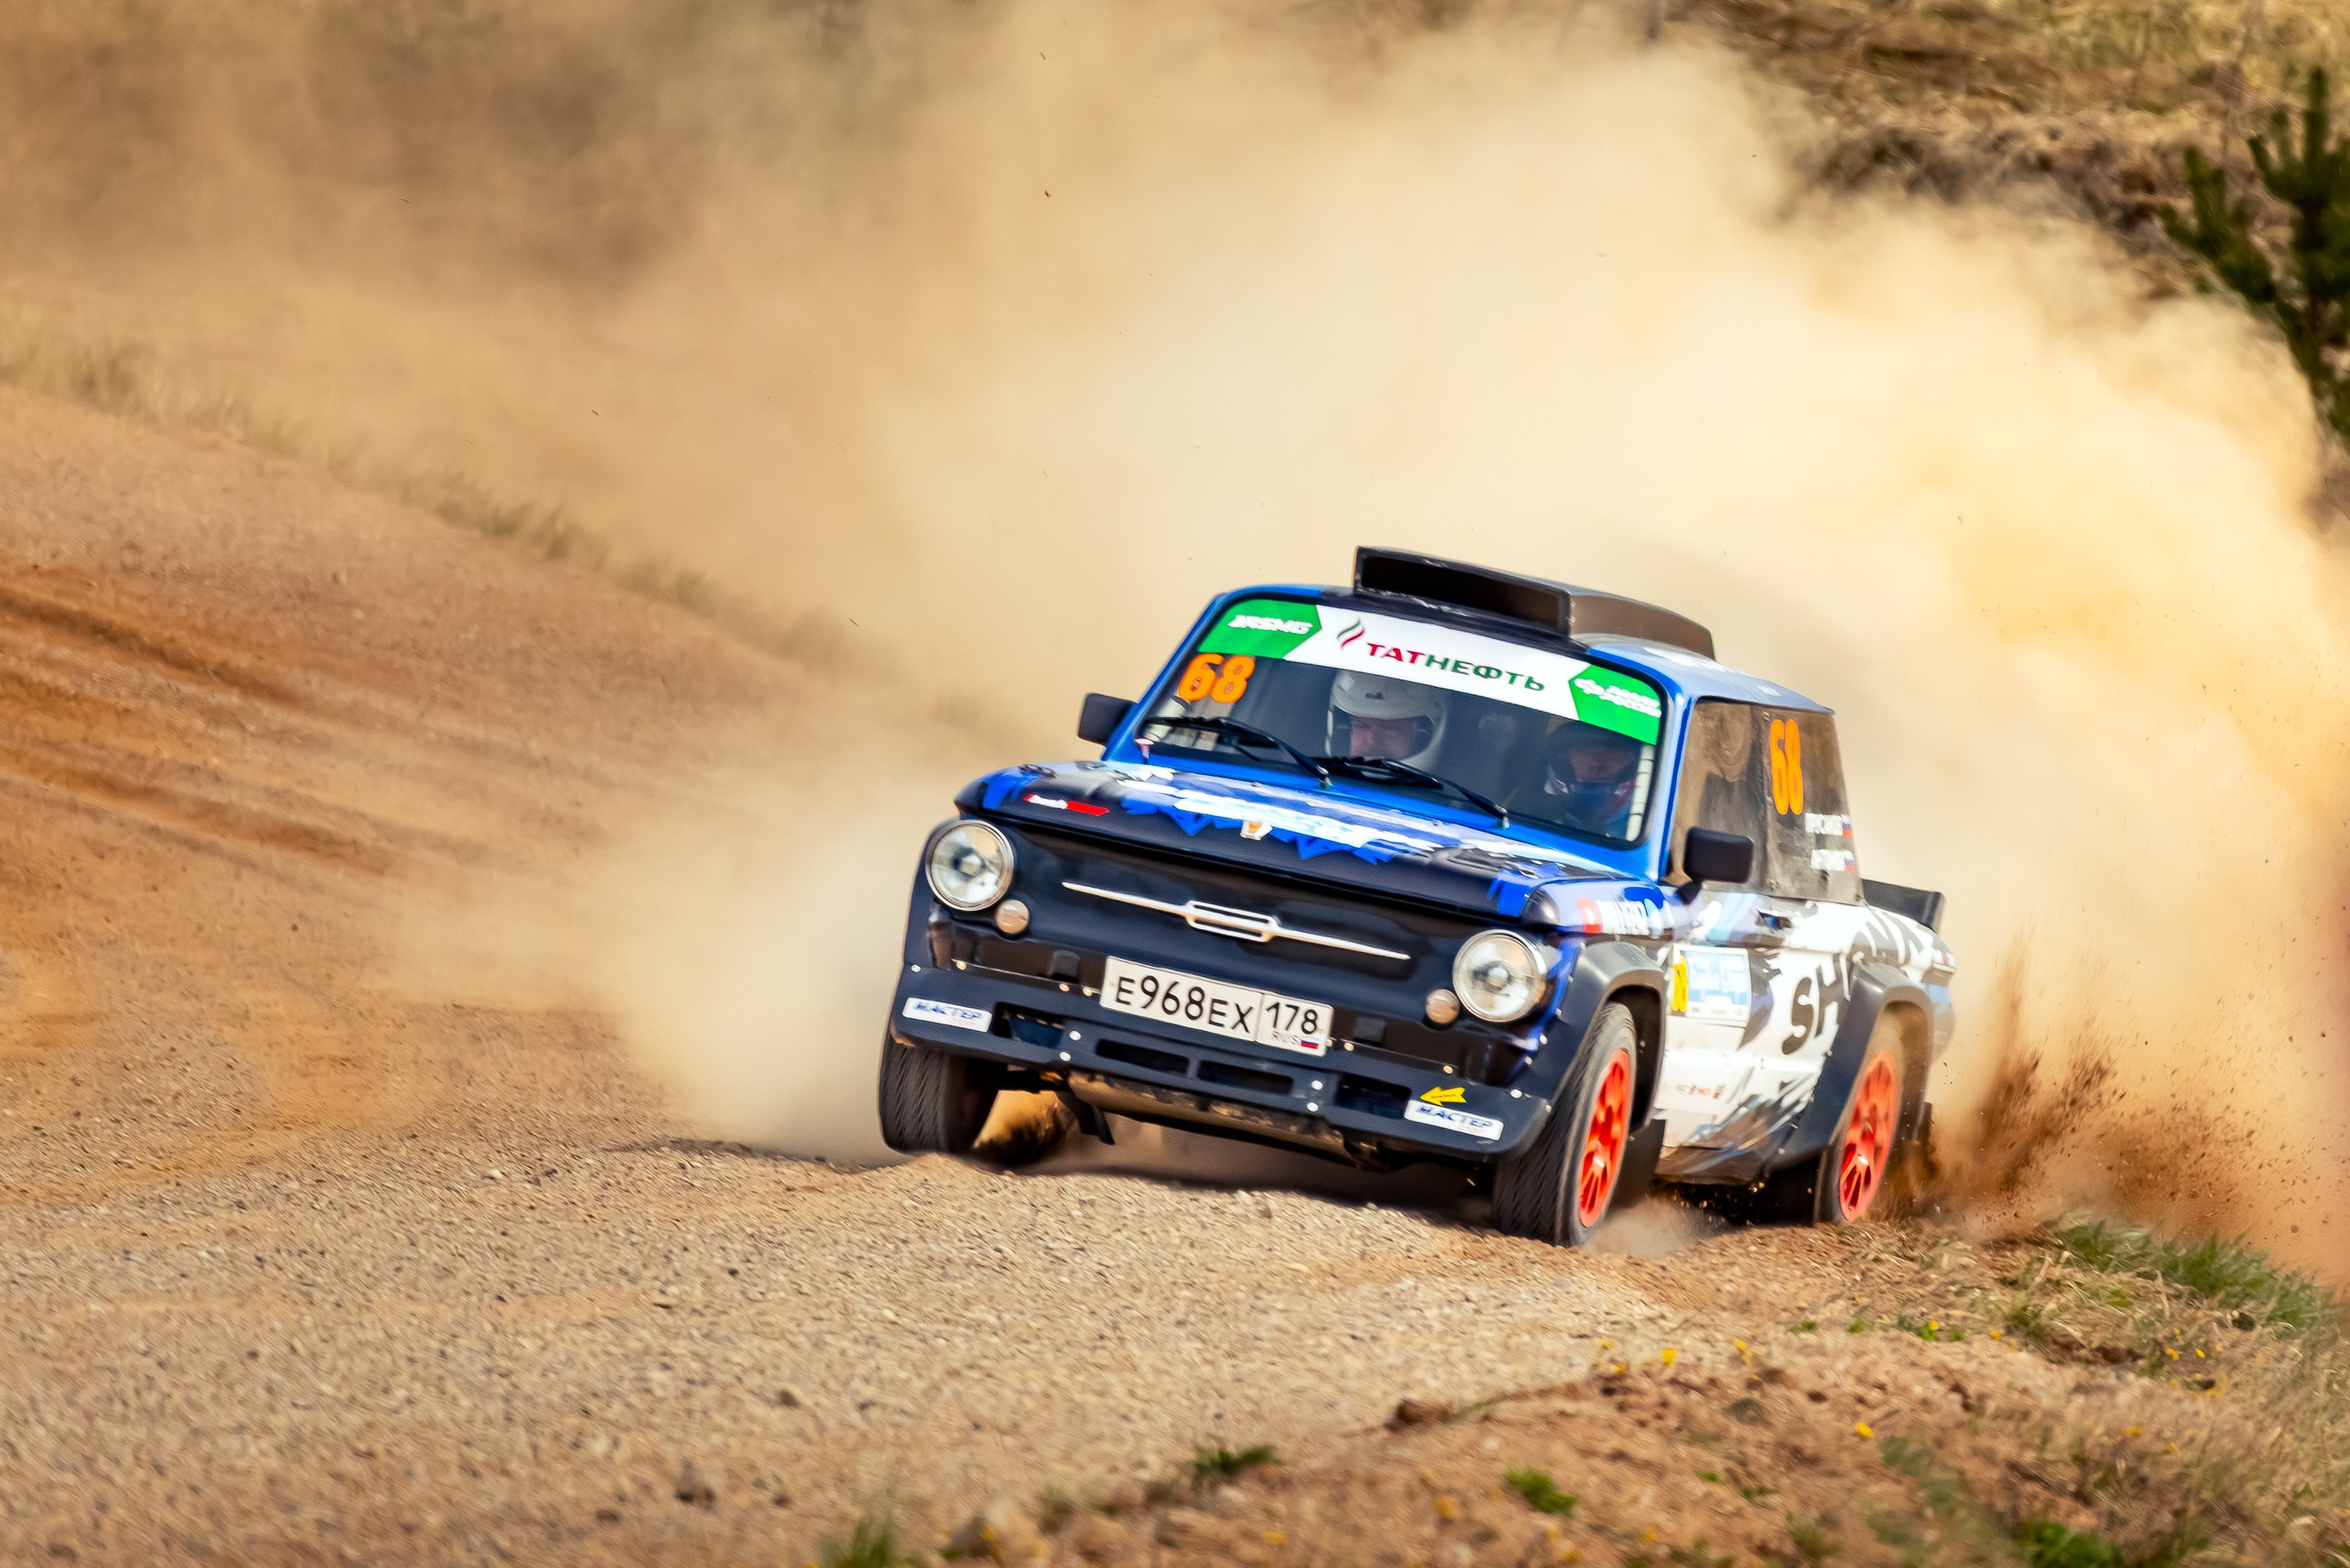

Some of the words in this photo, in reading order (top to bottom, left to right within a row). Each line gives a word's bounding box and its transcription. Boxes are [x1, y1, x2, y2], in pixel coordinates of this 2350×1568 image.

[1179, 653, 1256, 704] 68
[1367, 643, 1545, 691] ТАТНЕФТЬ
[1770, 719, 1804, 815] 68
[1266, 1002, 1319, 1035] 178
